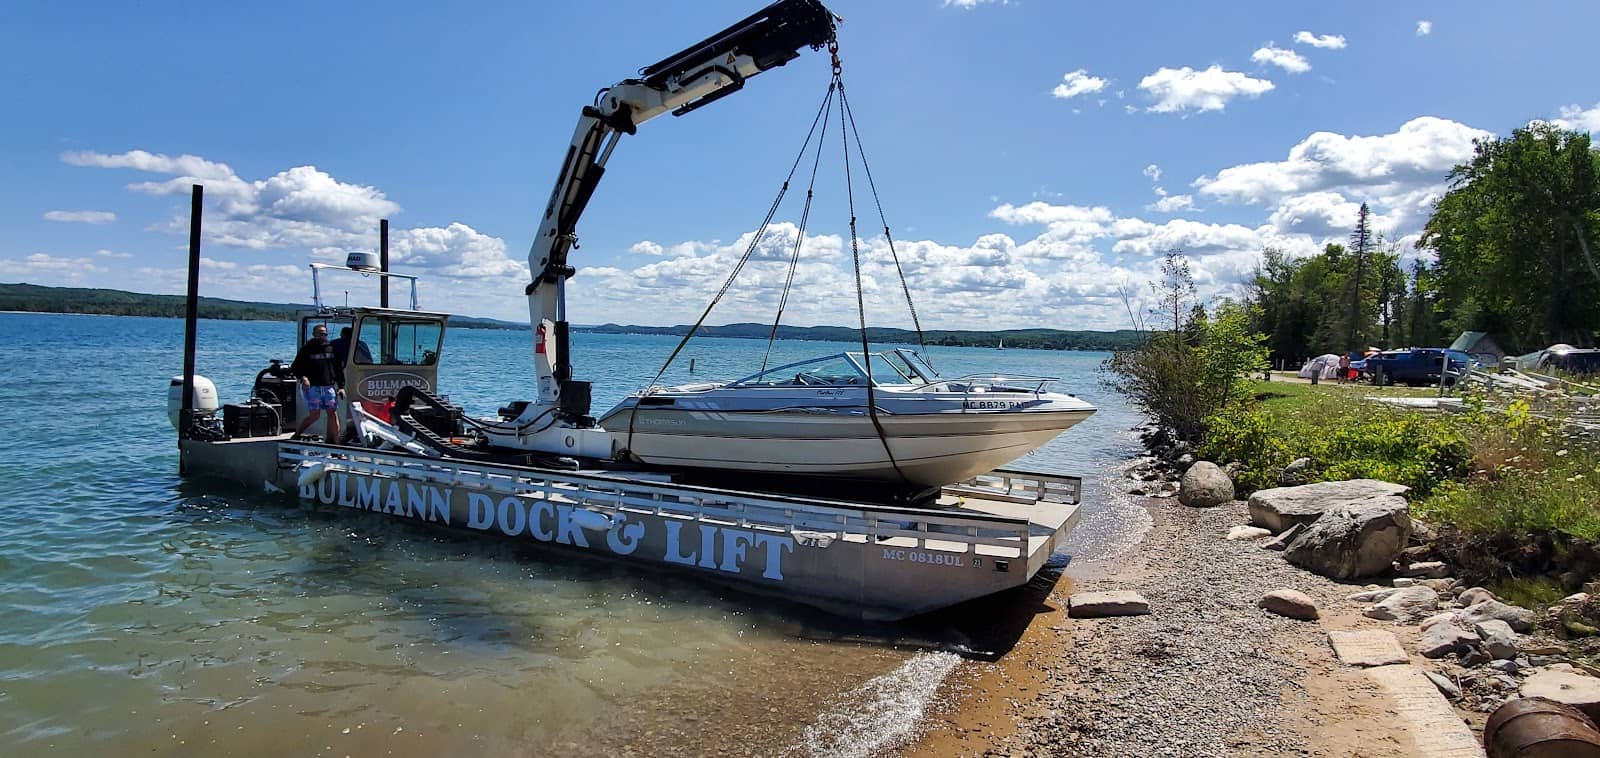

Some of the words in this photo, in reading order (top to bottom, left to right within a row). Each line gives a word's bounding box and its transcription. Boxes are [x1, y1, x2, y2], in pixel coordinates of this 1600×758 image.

[367, 379, 421, 390] BULMANN
[367, 389, 393, 397] DOCK
[466, 492, 590, 549] DOCK
[606, 512, 645, 555] &
[663, 520, 793, 581] LIFT
[882, 549, 905, 561] MC
